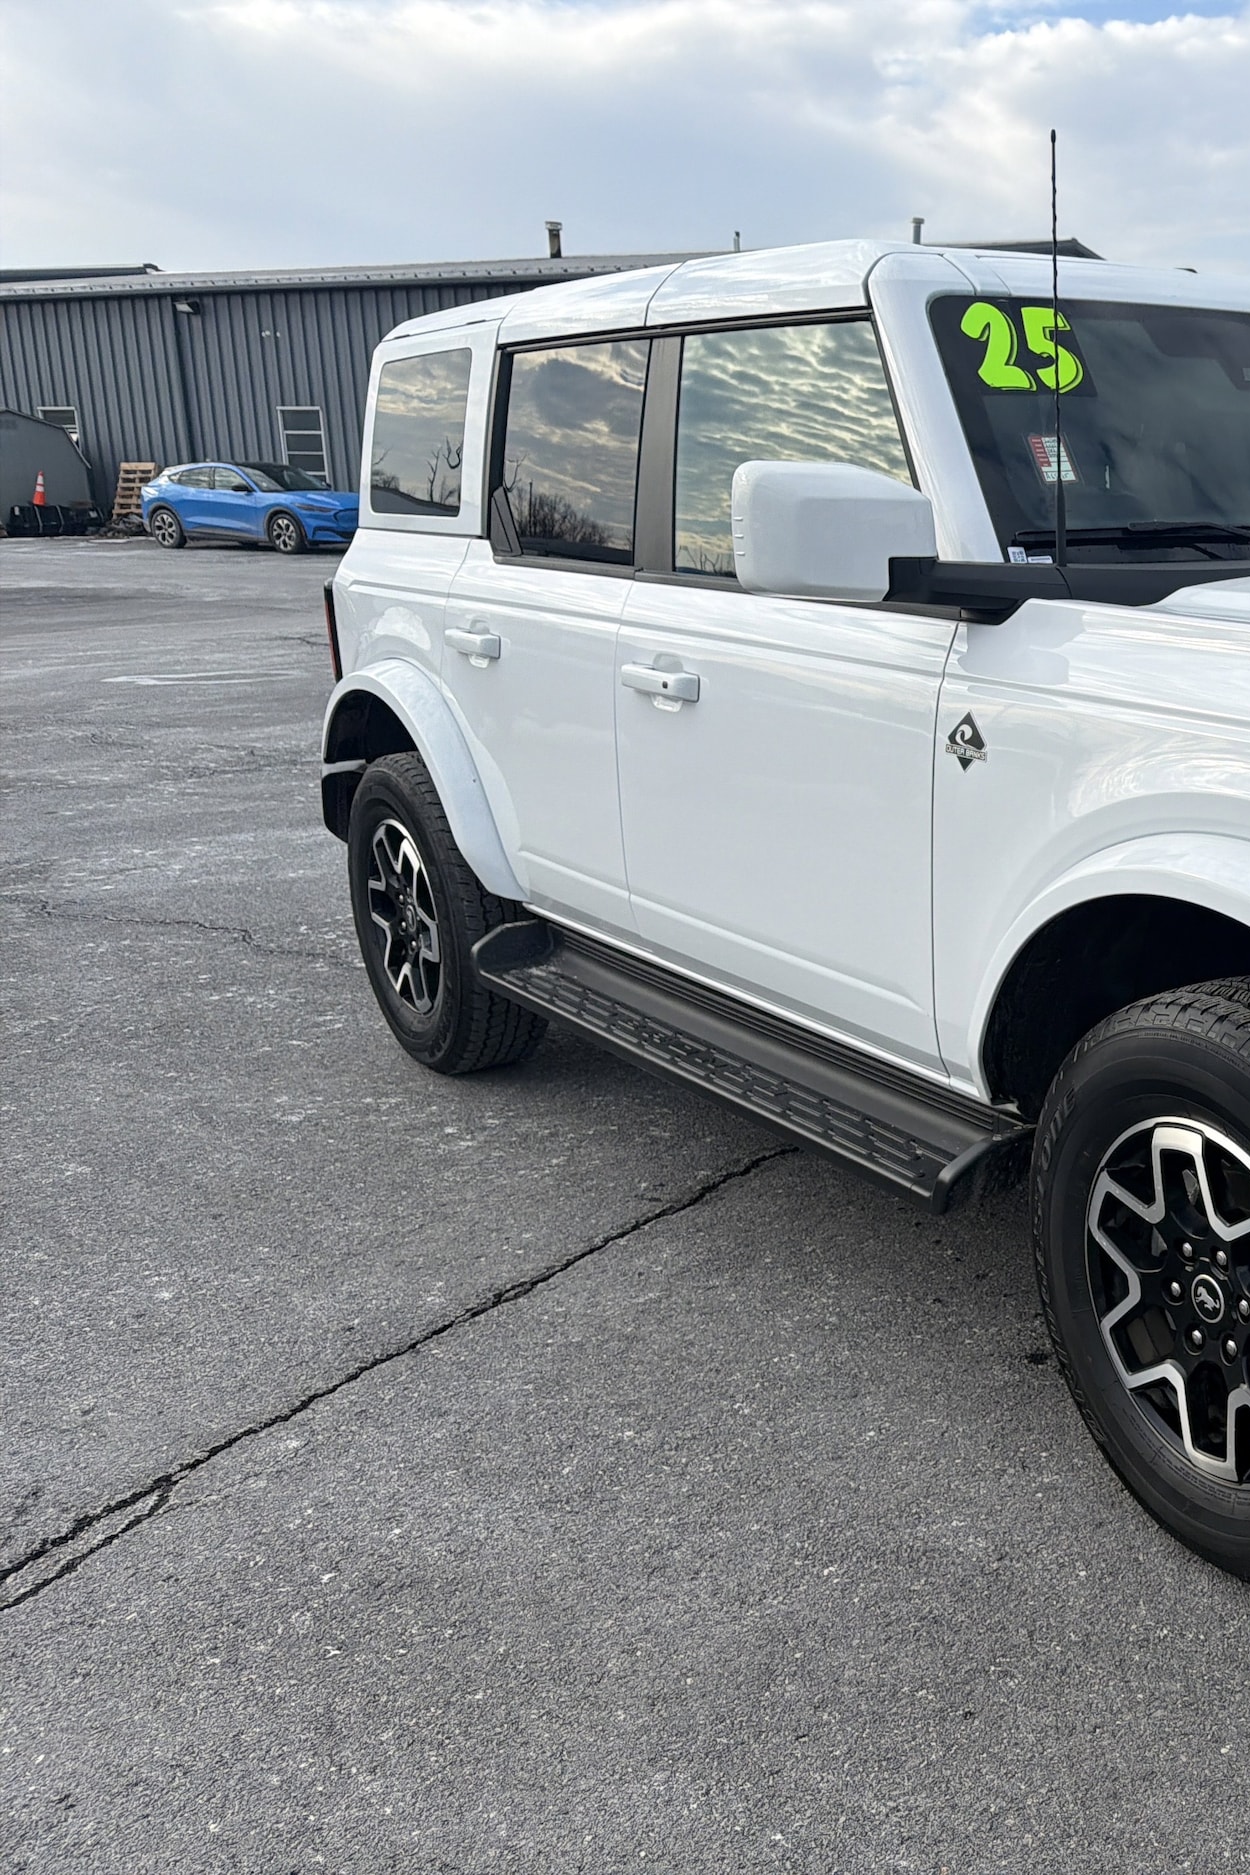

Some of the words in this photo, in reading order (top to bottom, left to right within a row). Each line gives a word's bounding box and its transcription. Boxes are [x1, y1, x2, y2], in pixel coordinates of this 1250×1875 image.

[960, 301, 1084, 394] 25
[947, 745, 965, 756] OUTER
[966, 749, 985, 760] BANKS
